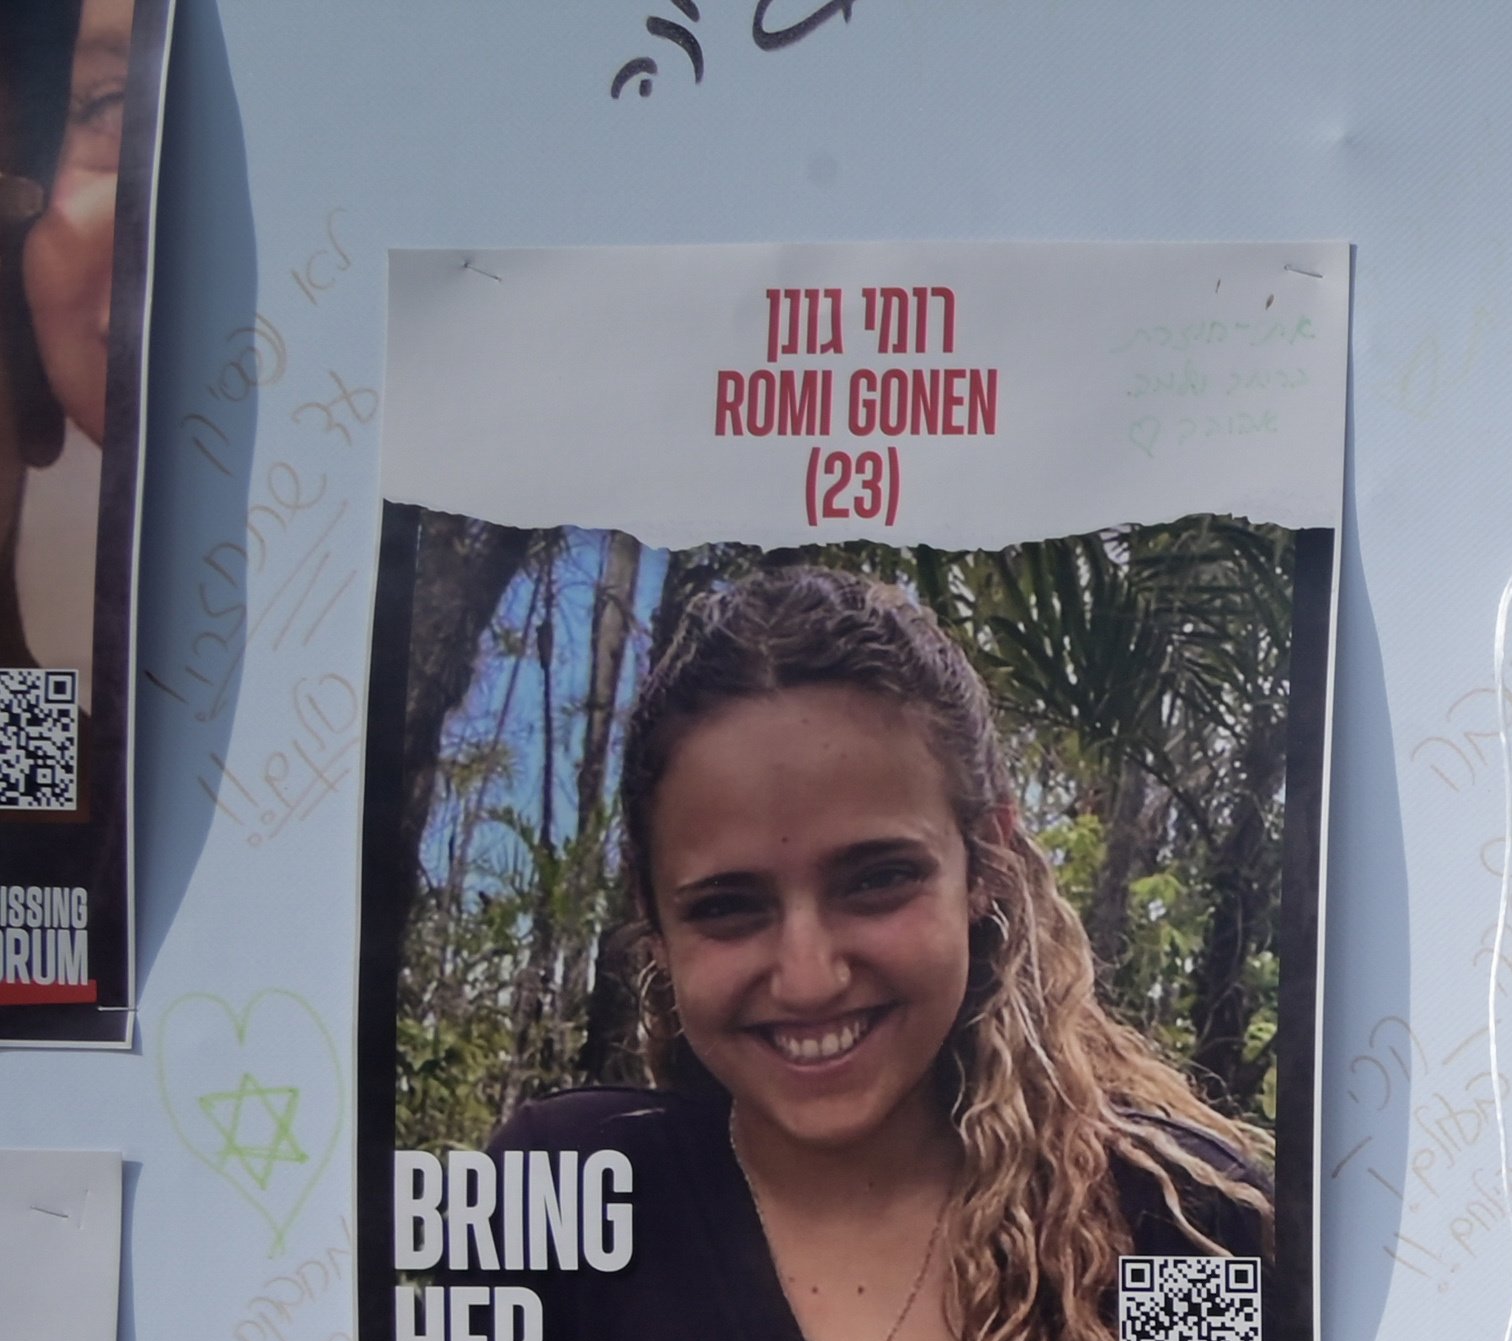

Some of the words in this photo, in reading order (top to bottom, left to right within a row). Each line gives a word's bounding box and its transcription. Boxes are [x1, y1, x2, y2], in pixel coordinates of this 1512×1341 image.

[769, 288, 843, 361] גונן
[865, 288, 955, 352] רומי
[718, 371, 832, 435] ROMI
[851, 369, 998, 435] GONEN
[808, 448, 900, 525] (23)
